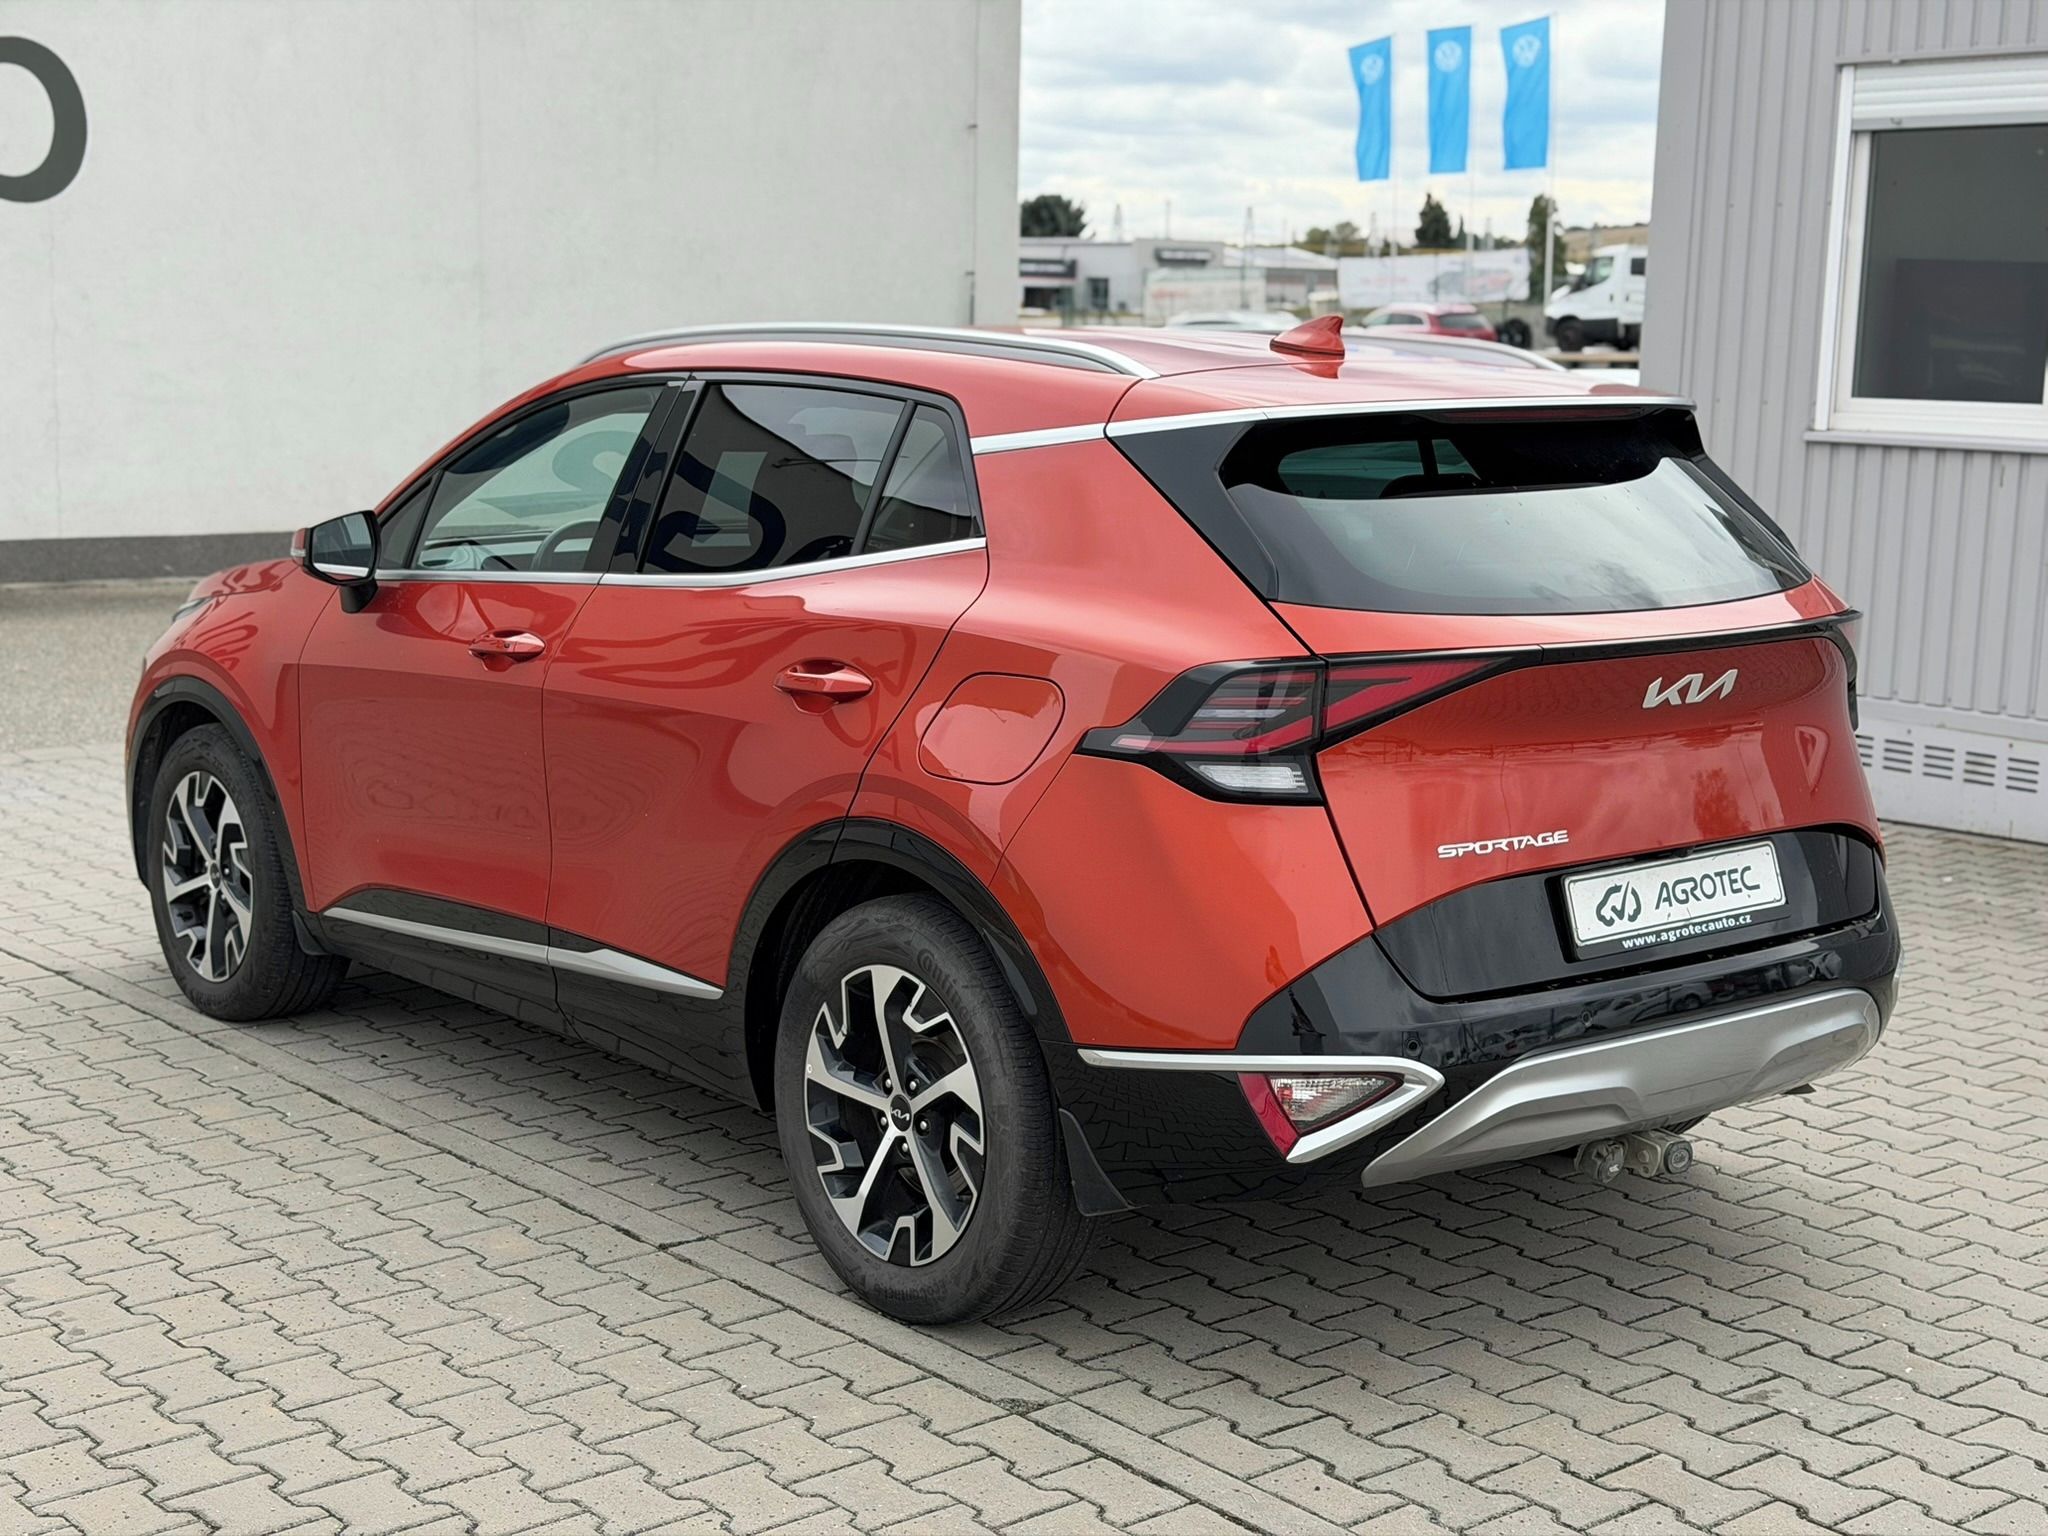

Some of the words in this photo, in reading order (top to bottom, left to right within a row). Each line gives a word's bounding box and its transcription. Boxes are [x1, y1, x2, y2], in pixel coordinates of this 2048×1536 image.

[1437, 829, 1569, 858] SPORTAGE
[1655, 865, 1760, 910] AGROTEC
[1622, 914, 1752, 949] www.agrotecauto.cz
